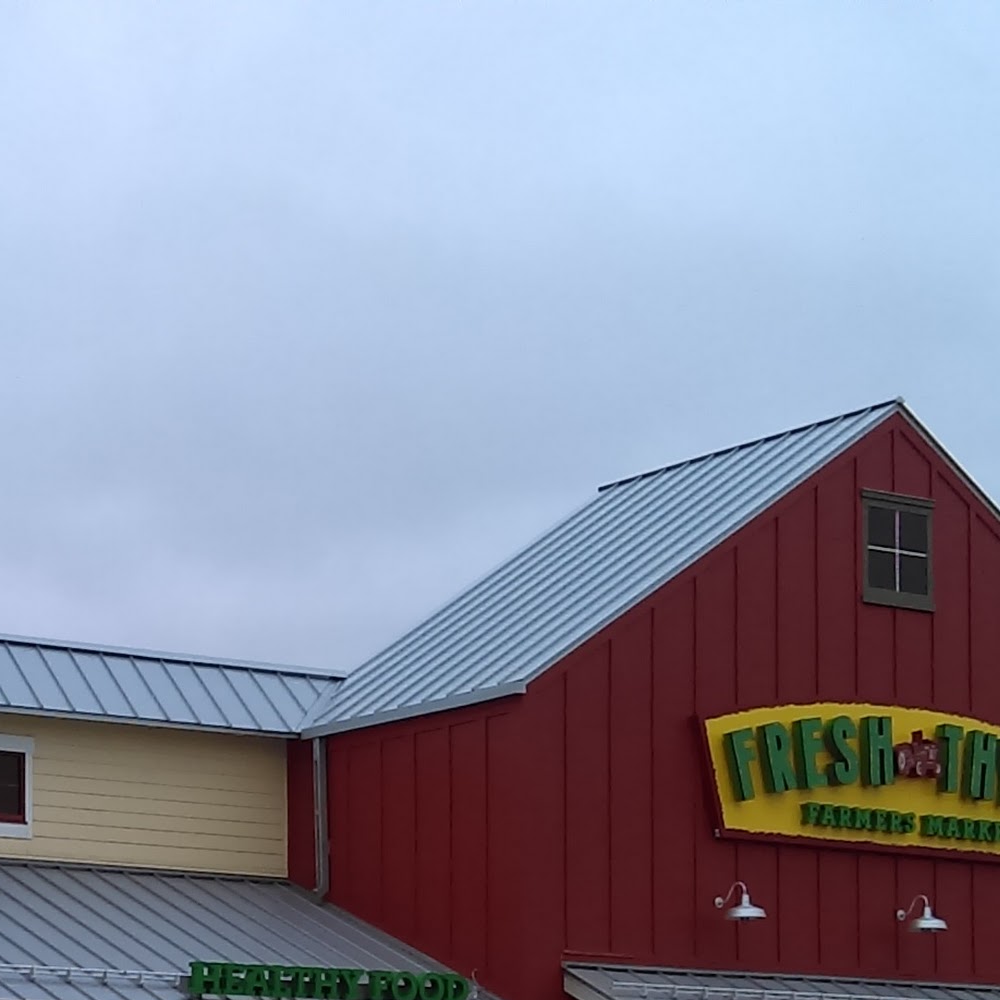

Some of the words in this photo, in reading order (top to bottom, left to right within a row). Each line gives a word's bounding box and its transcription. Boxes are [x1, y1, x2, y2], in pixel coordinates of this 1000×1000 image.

[724, 716, 895, 801] FRESH
[936, 724, 1000, 801] TH
[801, 803, 916, 833] FARMERS
[189, 962, 363, 1000] HEALTHY
